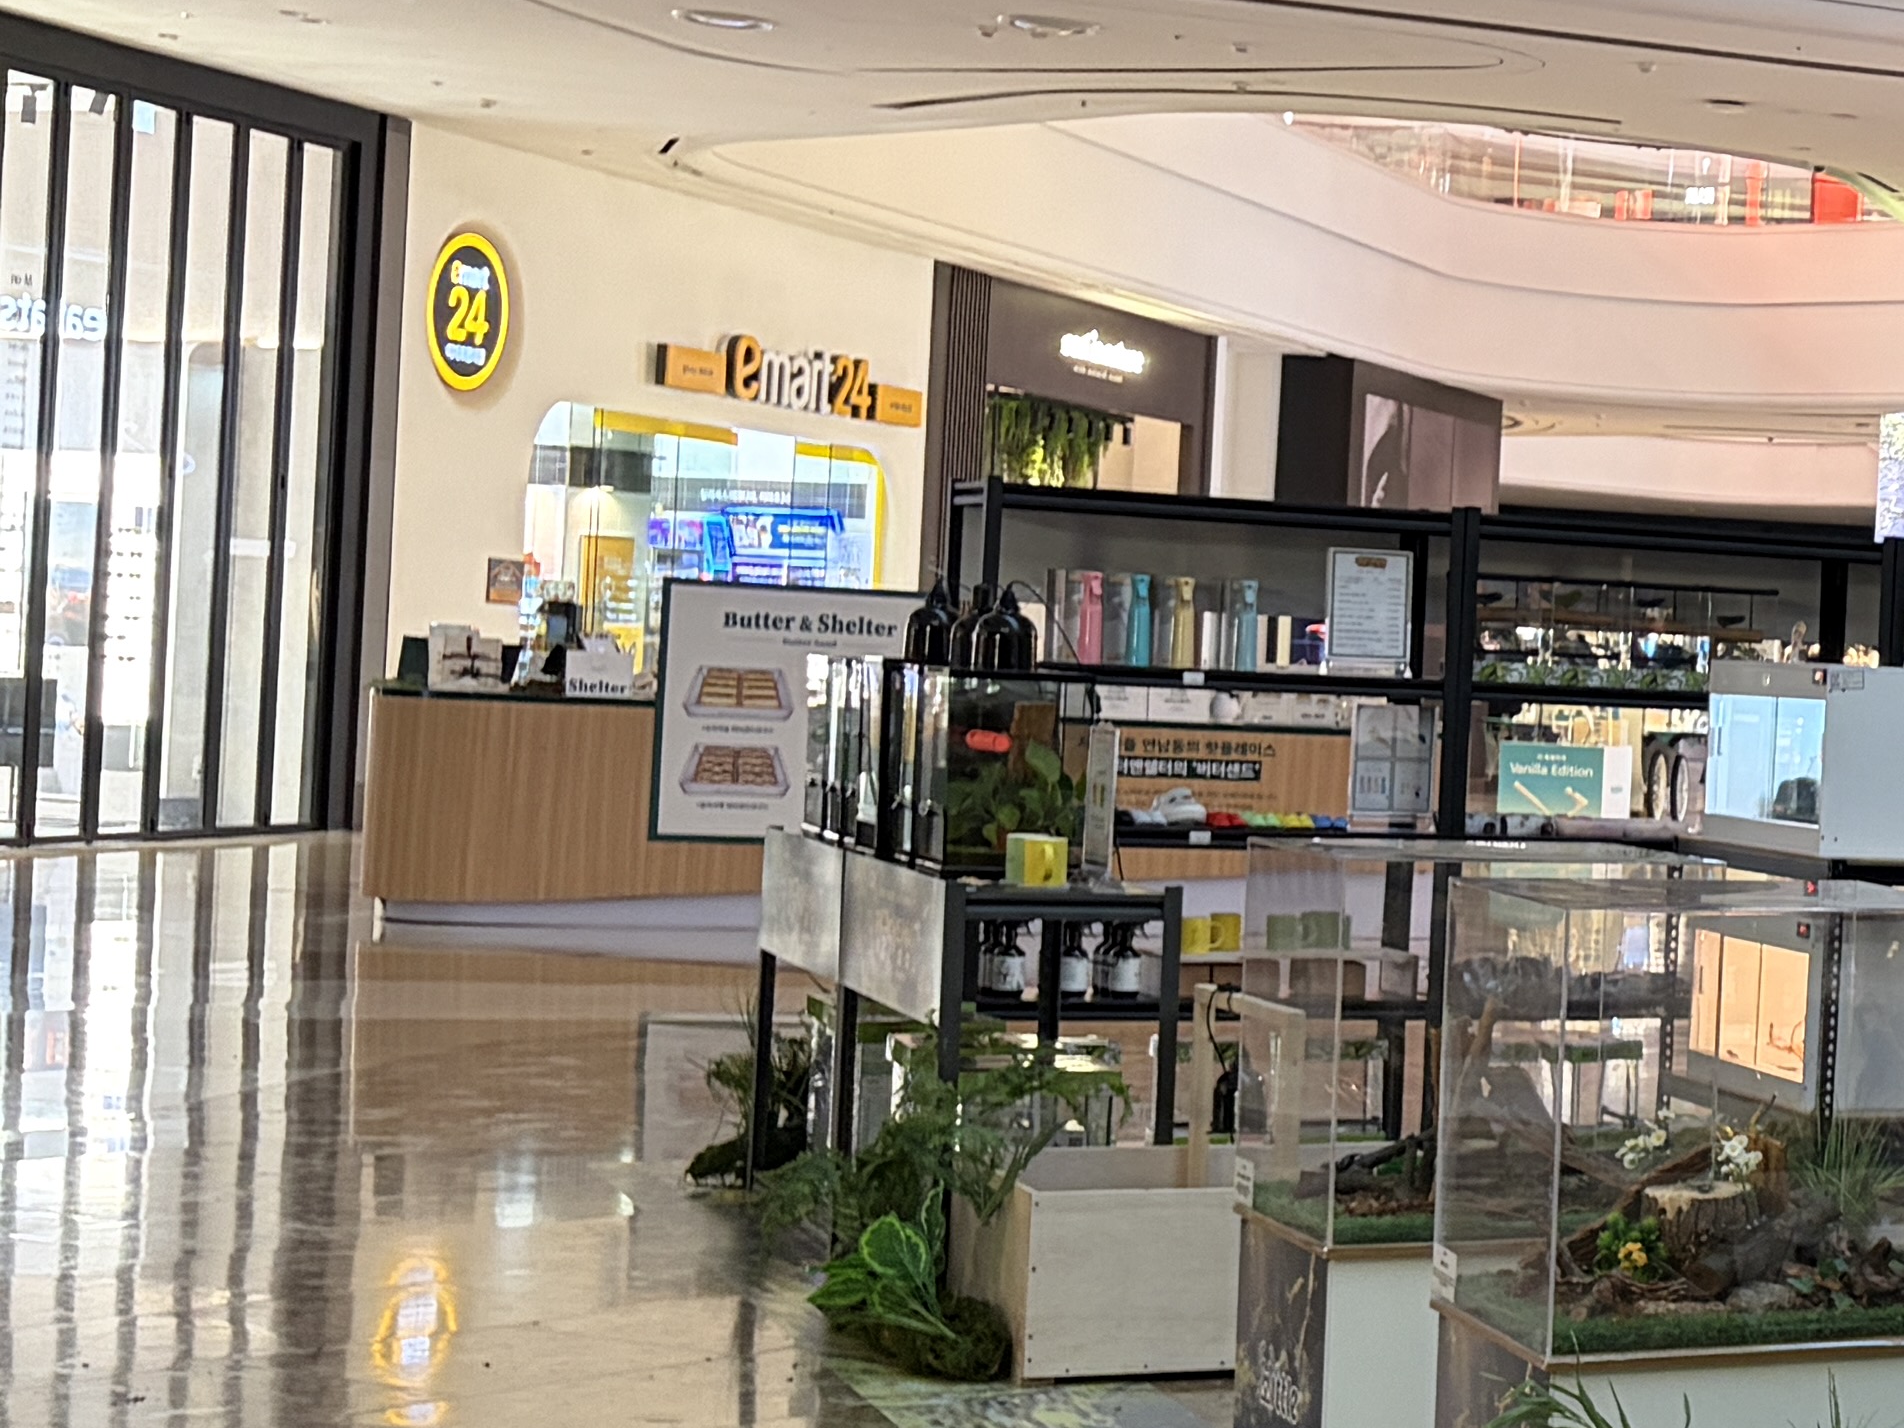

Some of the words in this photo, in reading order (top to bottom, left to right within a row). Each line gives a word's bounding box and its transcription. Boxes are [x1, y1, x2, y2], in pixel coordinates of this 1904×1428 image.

[447, 286, 490, 345] 24
[723, 611, 796, 630] Butter
[799, 616, 813, 633] &
[817, 613, 897, 637] Shelter
[1510, 762, 1548, 777] Vanilla
[1551, 763, 1593, 779] Edition
